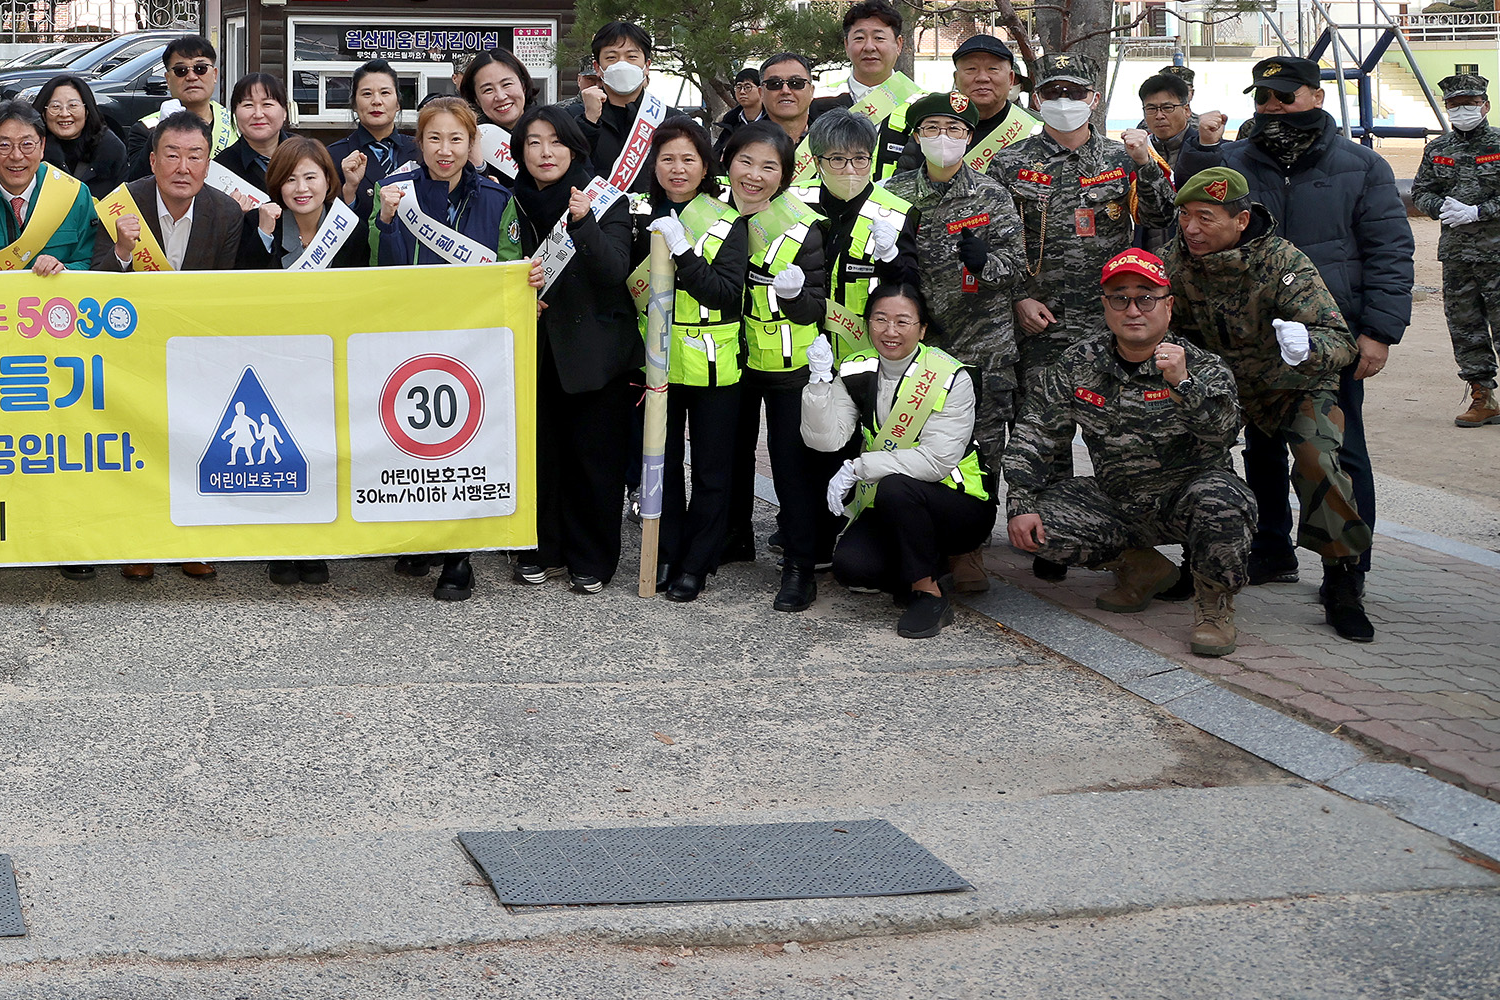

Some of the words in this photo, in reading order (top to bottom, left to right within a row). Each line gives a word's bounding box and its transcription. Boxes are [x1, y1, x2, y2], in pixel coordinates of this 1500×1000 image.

[345, 29, 499, 52] 월산배움터지킴이실
[380, 51, 426, 59] 도와드릴까요?
[994, 118, 1024, 149] 자전거
[405, 208, 474, 264] 무단횡단
[1108, 254, 1159, 274] ROKMC
[16, 296, 138, 339] 5030
[827, 309, 865, 342] 자전거
[907, 368, 937, 411] 자전거
[406, 383, 458, 430] 30
[891, 412, 914, 439] 이용
[209, 470, 298, 490] 어린이보호구역
[380, 465, 487, 486] 어린이보호구역
[355, 486, 447, 505] 30km/h이하
[451, 482, 512, 503] 서행운전
